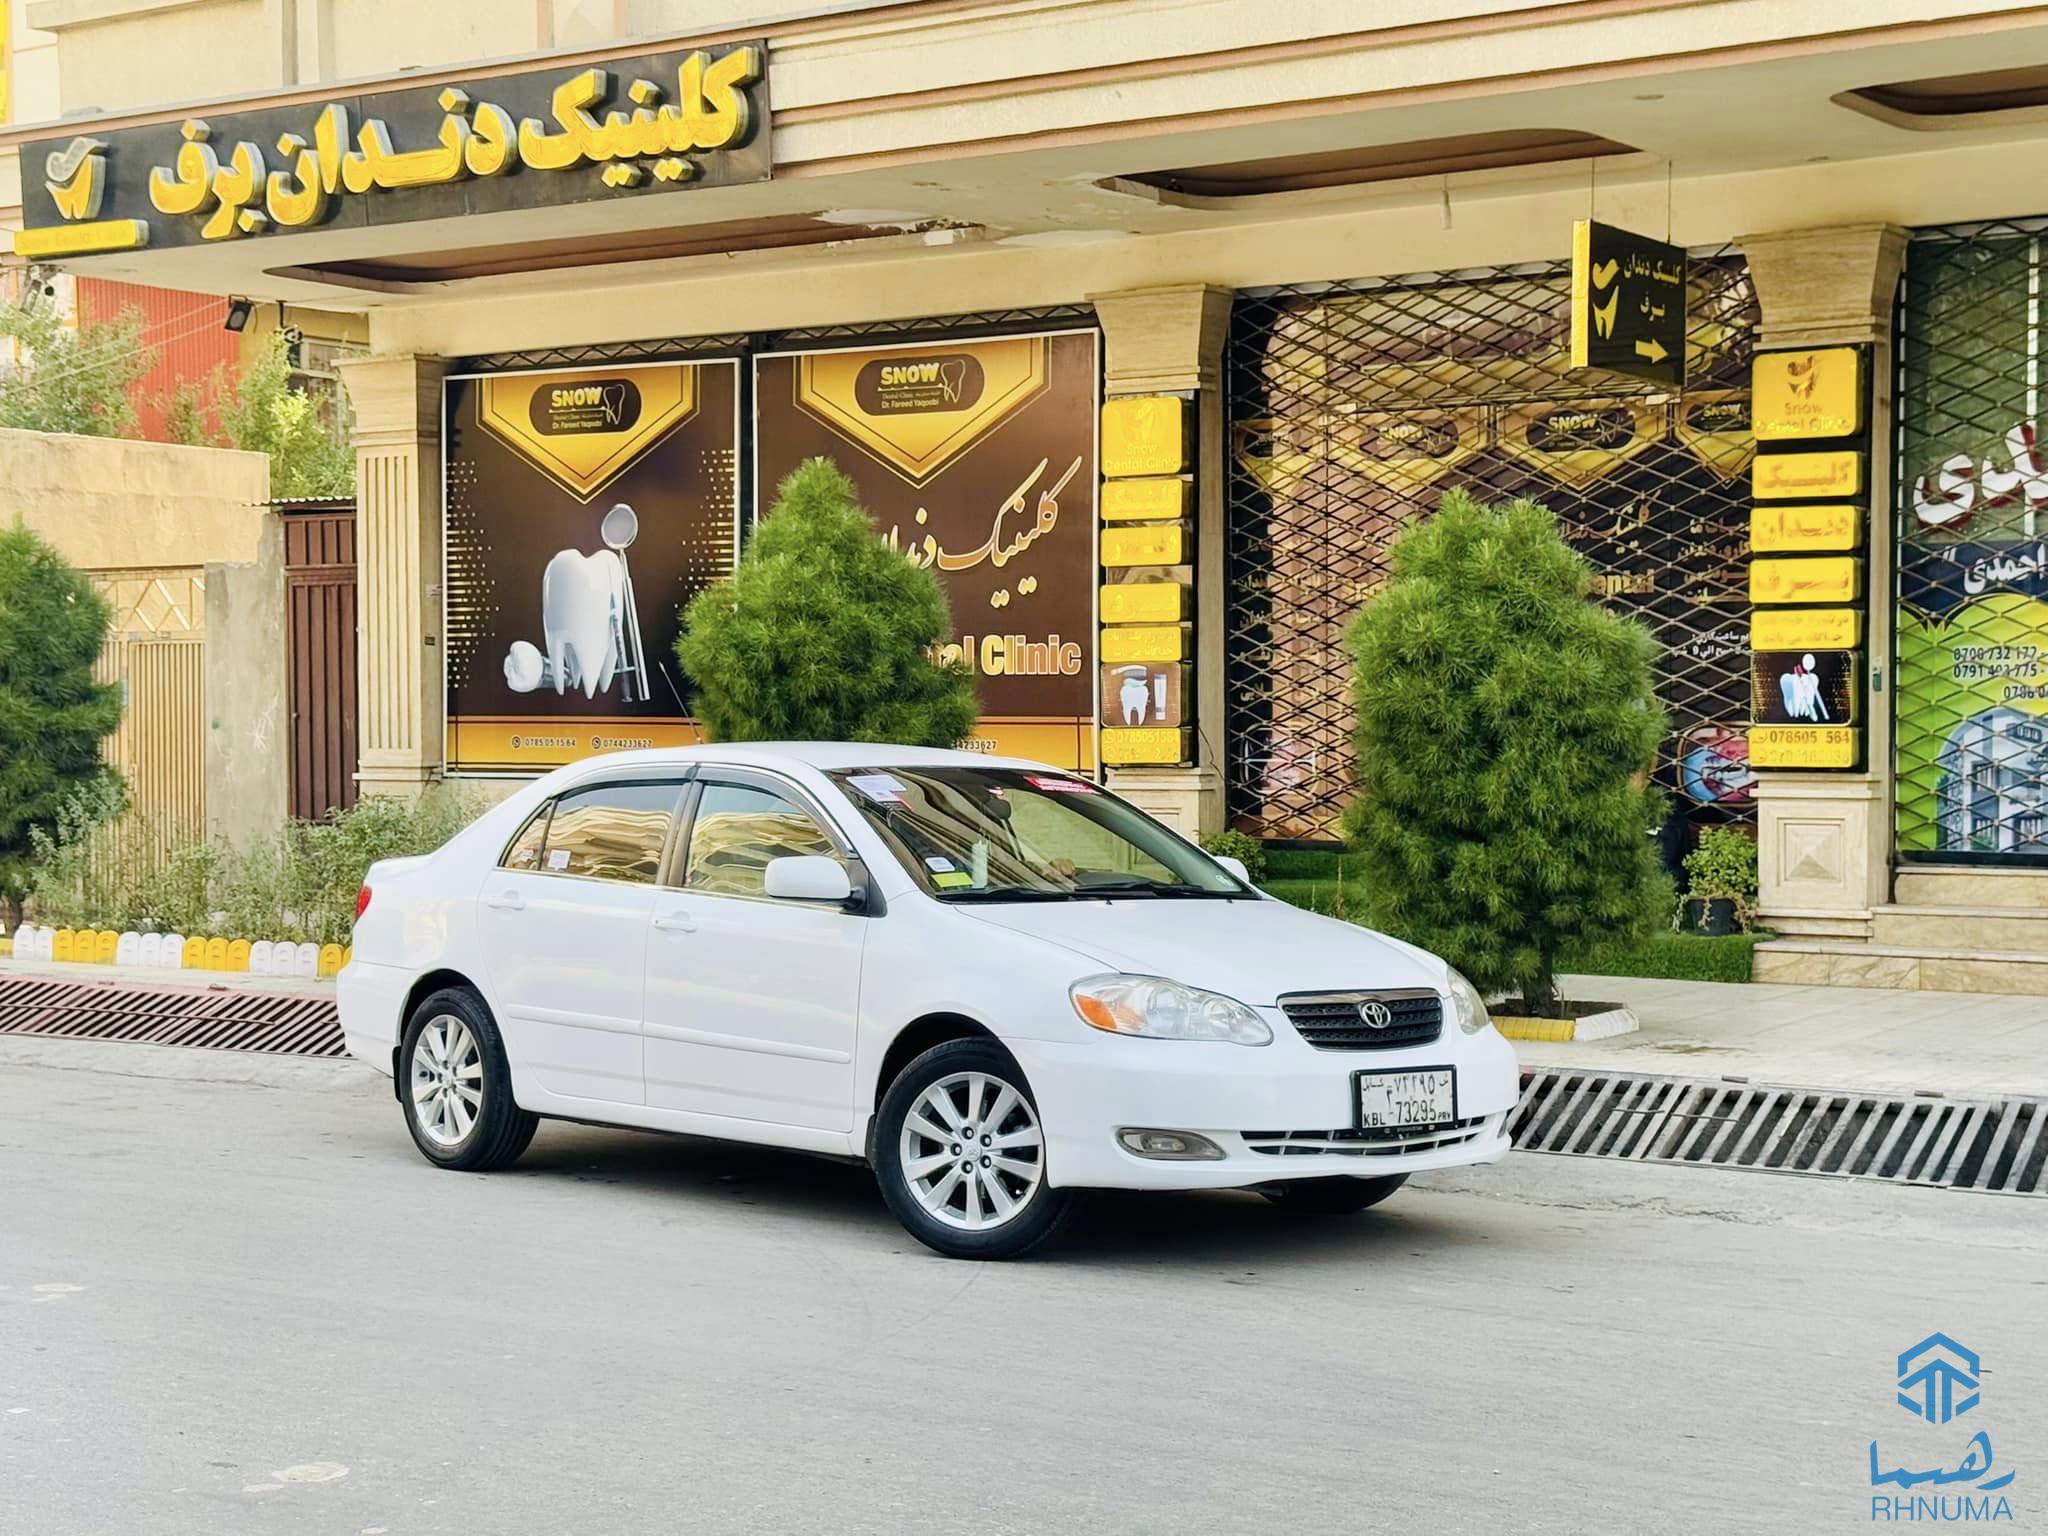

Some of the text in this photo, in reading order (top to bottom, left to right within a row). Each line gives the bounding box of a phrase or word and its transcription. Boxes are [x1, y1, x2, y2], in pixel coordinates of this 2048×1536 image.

[267, 87, 517, 226] دندان
[150, 117, 262, 240] برف
[881, 362, 940, 385] SNOW
[551, 386, 603, 407] SNOW
[1703, 403, 1741, 418] SNOW
[1549, 414, 1598, 431] SNOW
[981, 634, 1082, 676] Clinic
[1953, 665, 1984, 678] 0791
[1363, 1112, 1387, 1127] KBL
[1395, 1099, 1437, 1124] 73295
